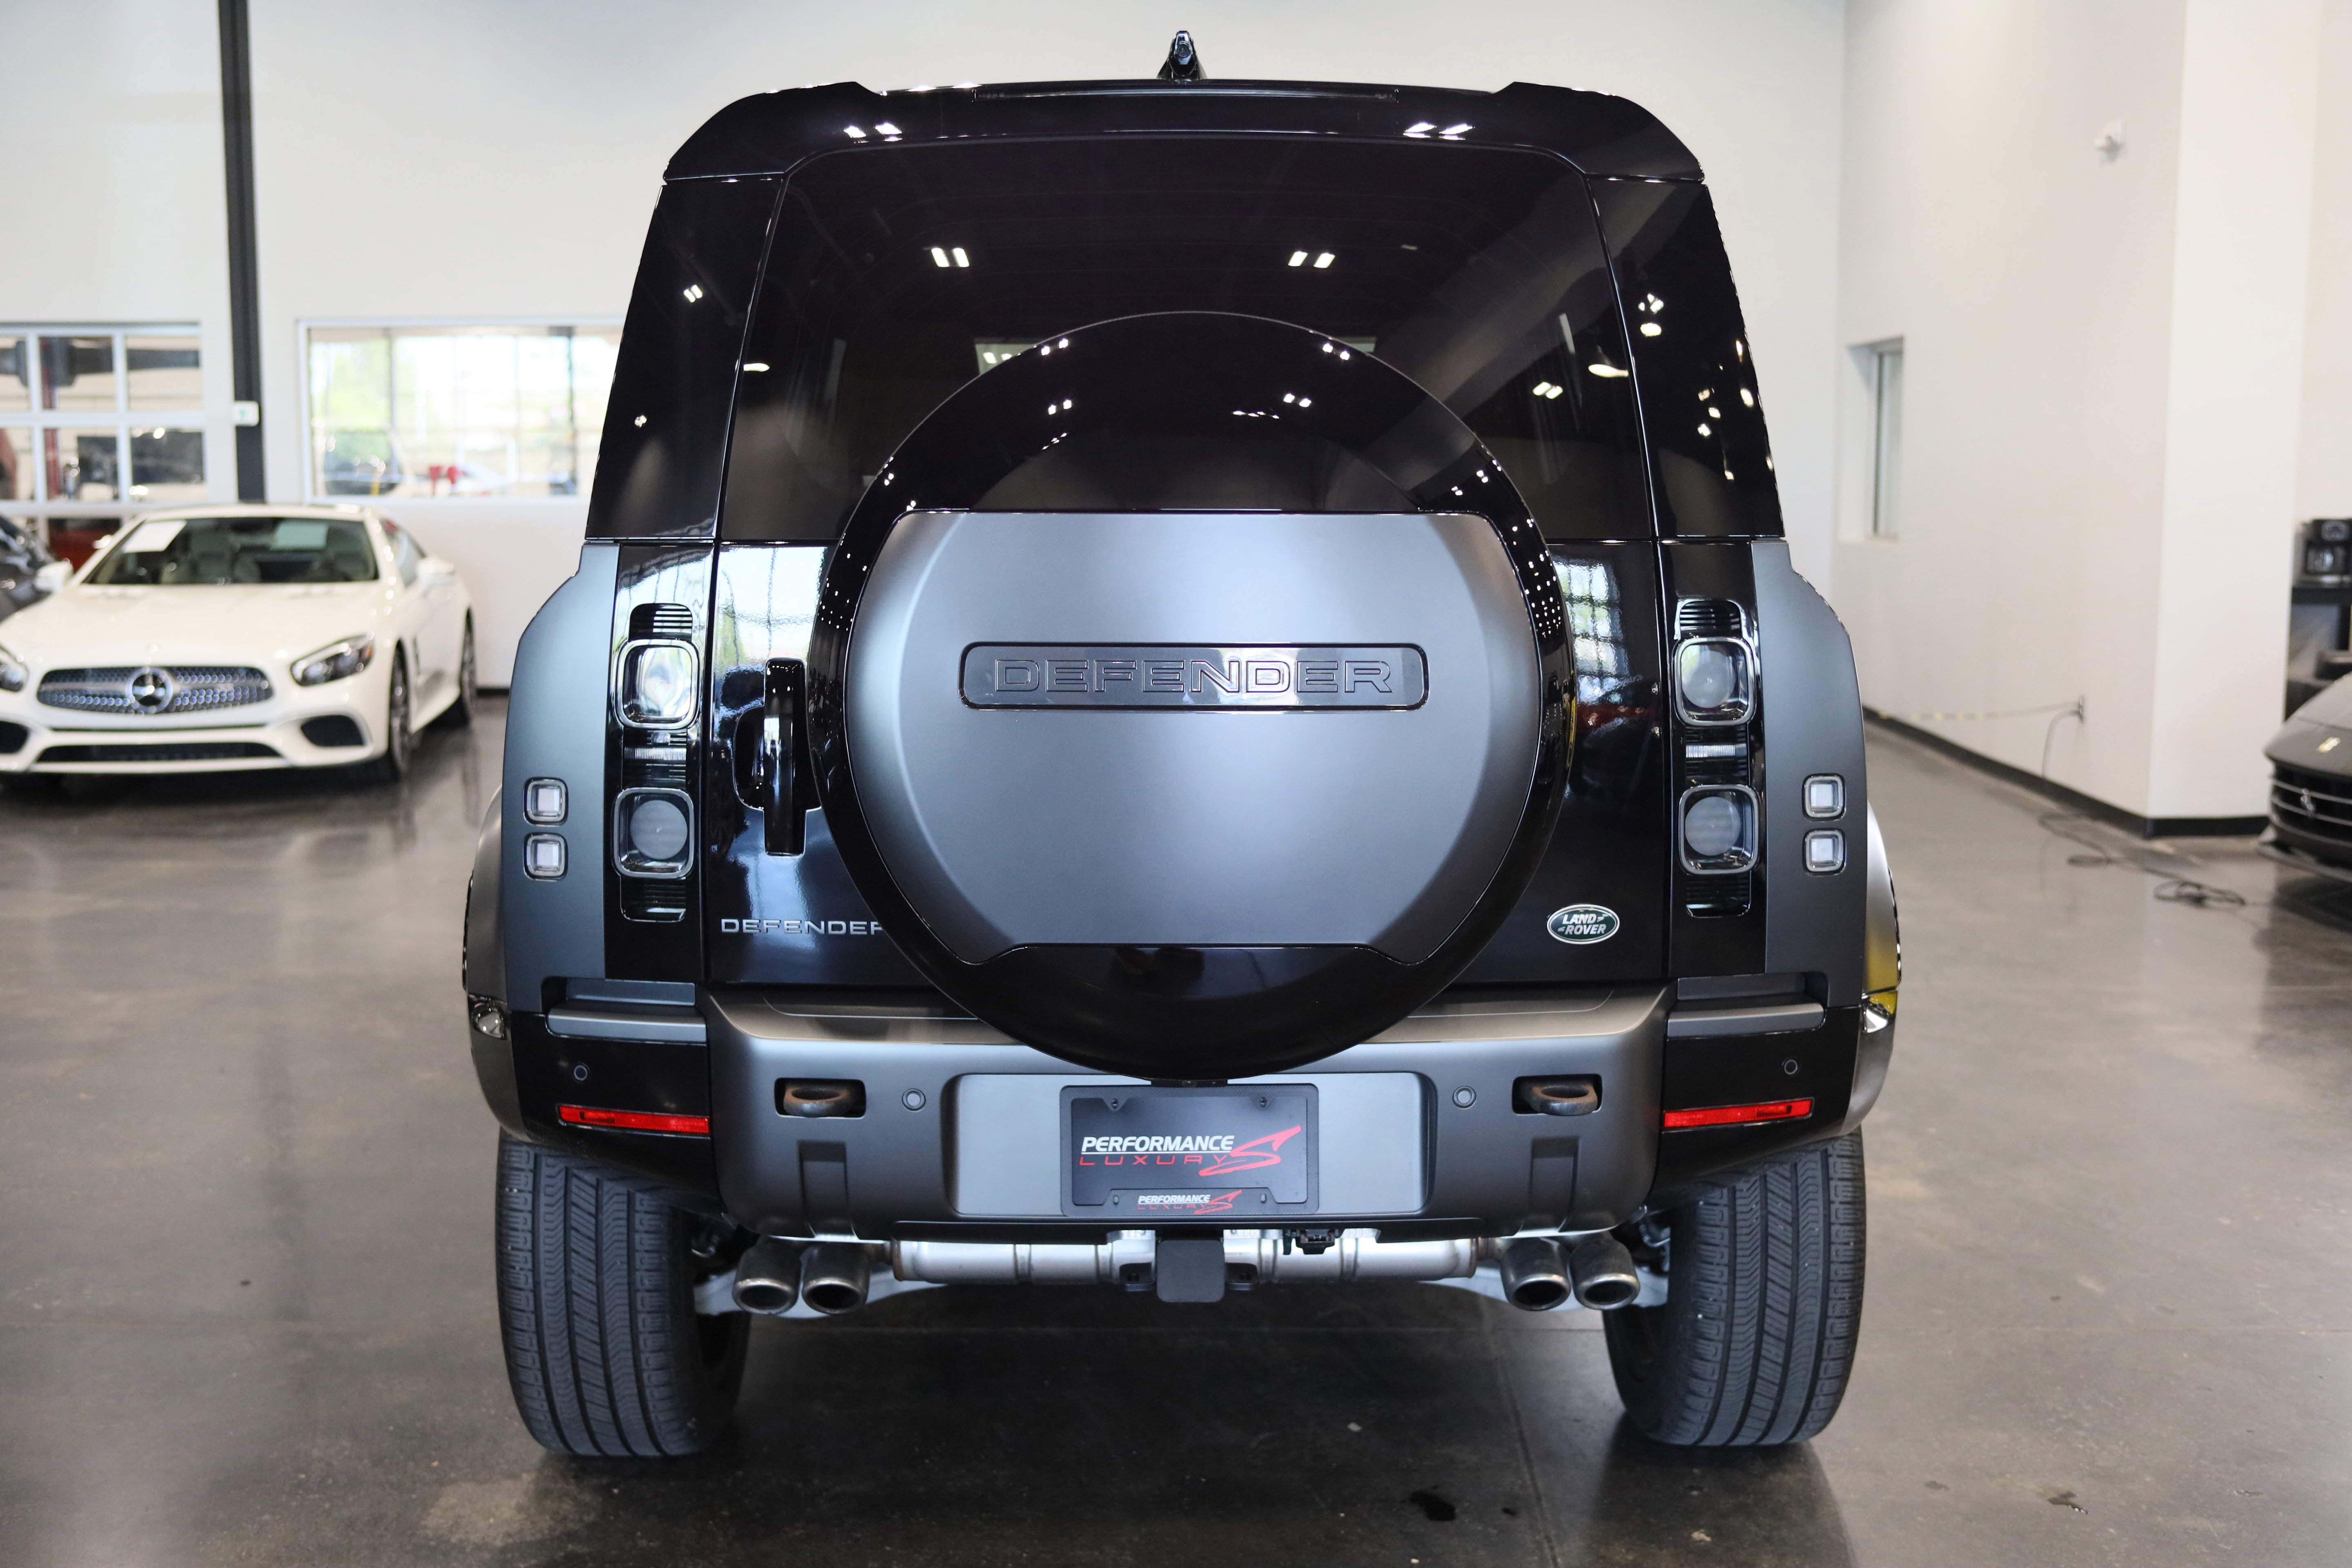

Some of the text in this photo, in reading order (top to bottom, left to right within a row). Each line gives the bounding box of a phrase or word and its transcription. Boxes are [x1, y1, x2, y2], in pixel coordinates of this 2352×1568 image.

[995, 659, 1393, 693] DEFENDER
[1562, 913, 1597, 924] LAND
[1564, 924, 1607, 935] ROVER
[1081, 1135, 1235, 1152] PERFORMANCE
[1079, 1155, 1228, 1166] LUXURY
[1138, 1194, 1211, 1203] PERFORMANCE
